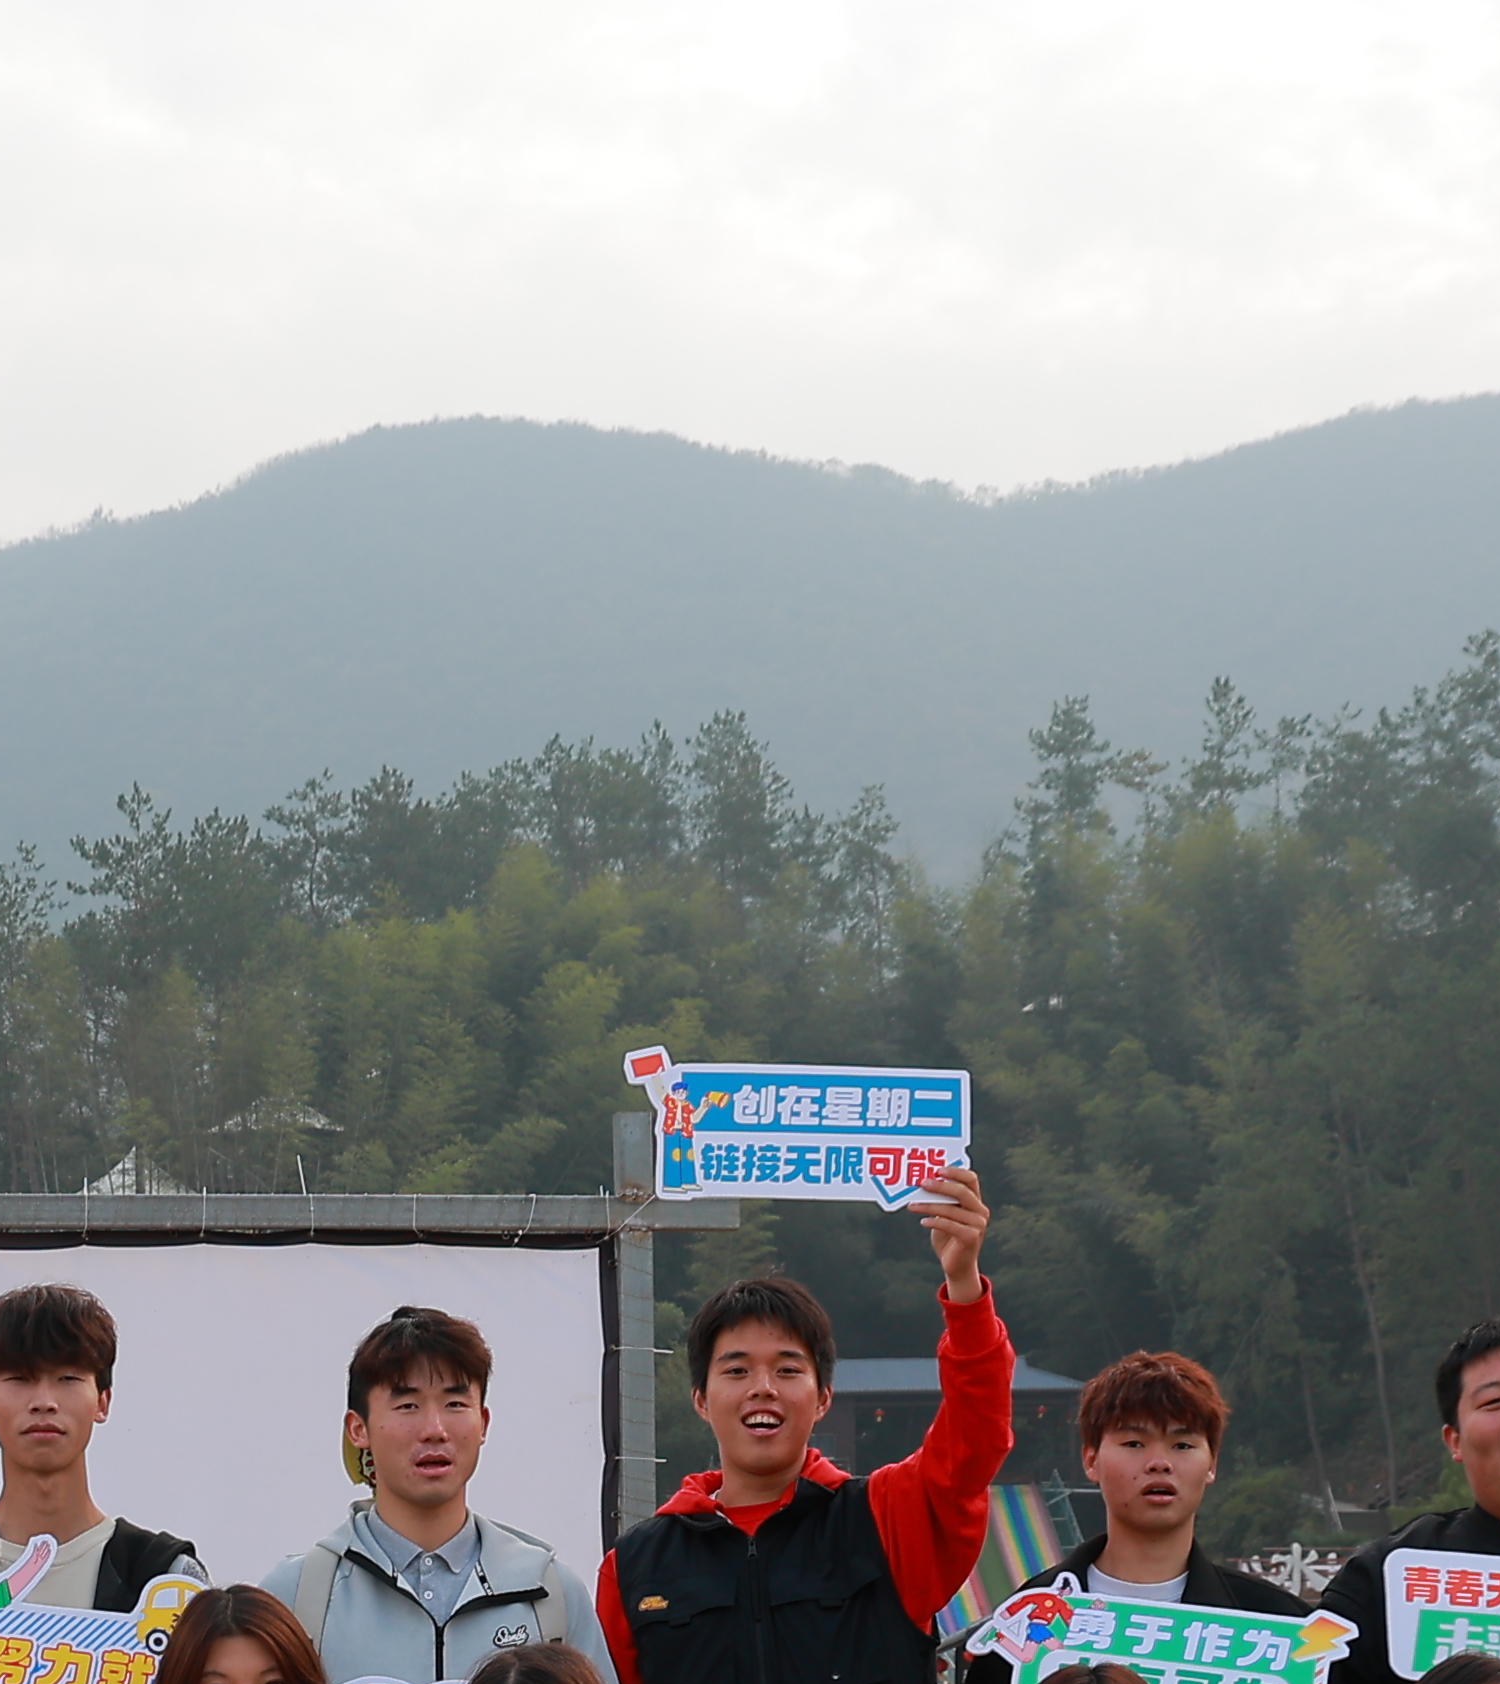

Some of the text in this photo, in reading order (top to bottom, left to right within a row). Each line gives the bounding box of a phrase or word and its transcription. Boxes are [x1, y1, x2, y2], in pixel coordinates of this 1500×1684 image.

[733, 1084, 953, 1128] 创在星期二
[701, 1143, 947, 1186] 链接无限可能
[1064, 1607, 1291, 1671] 勇于作为
